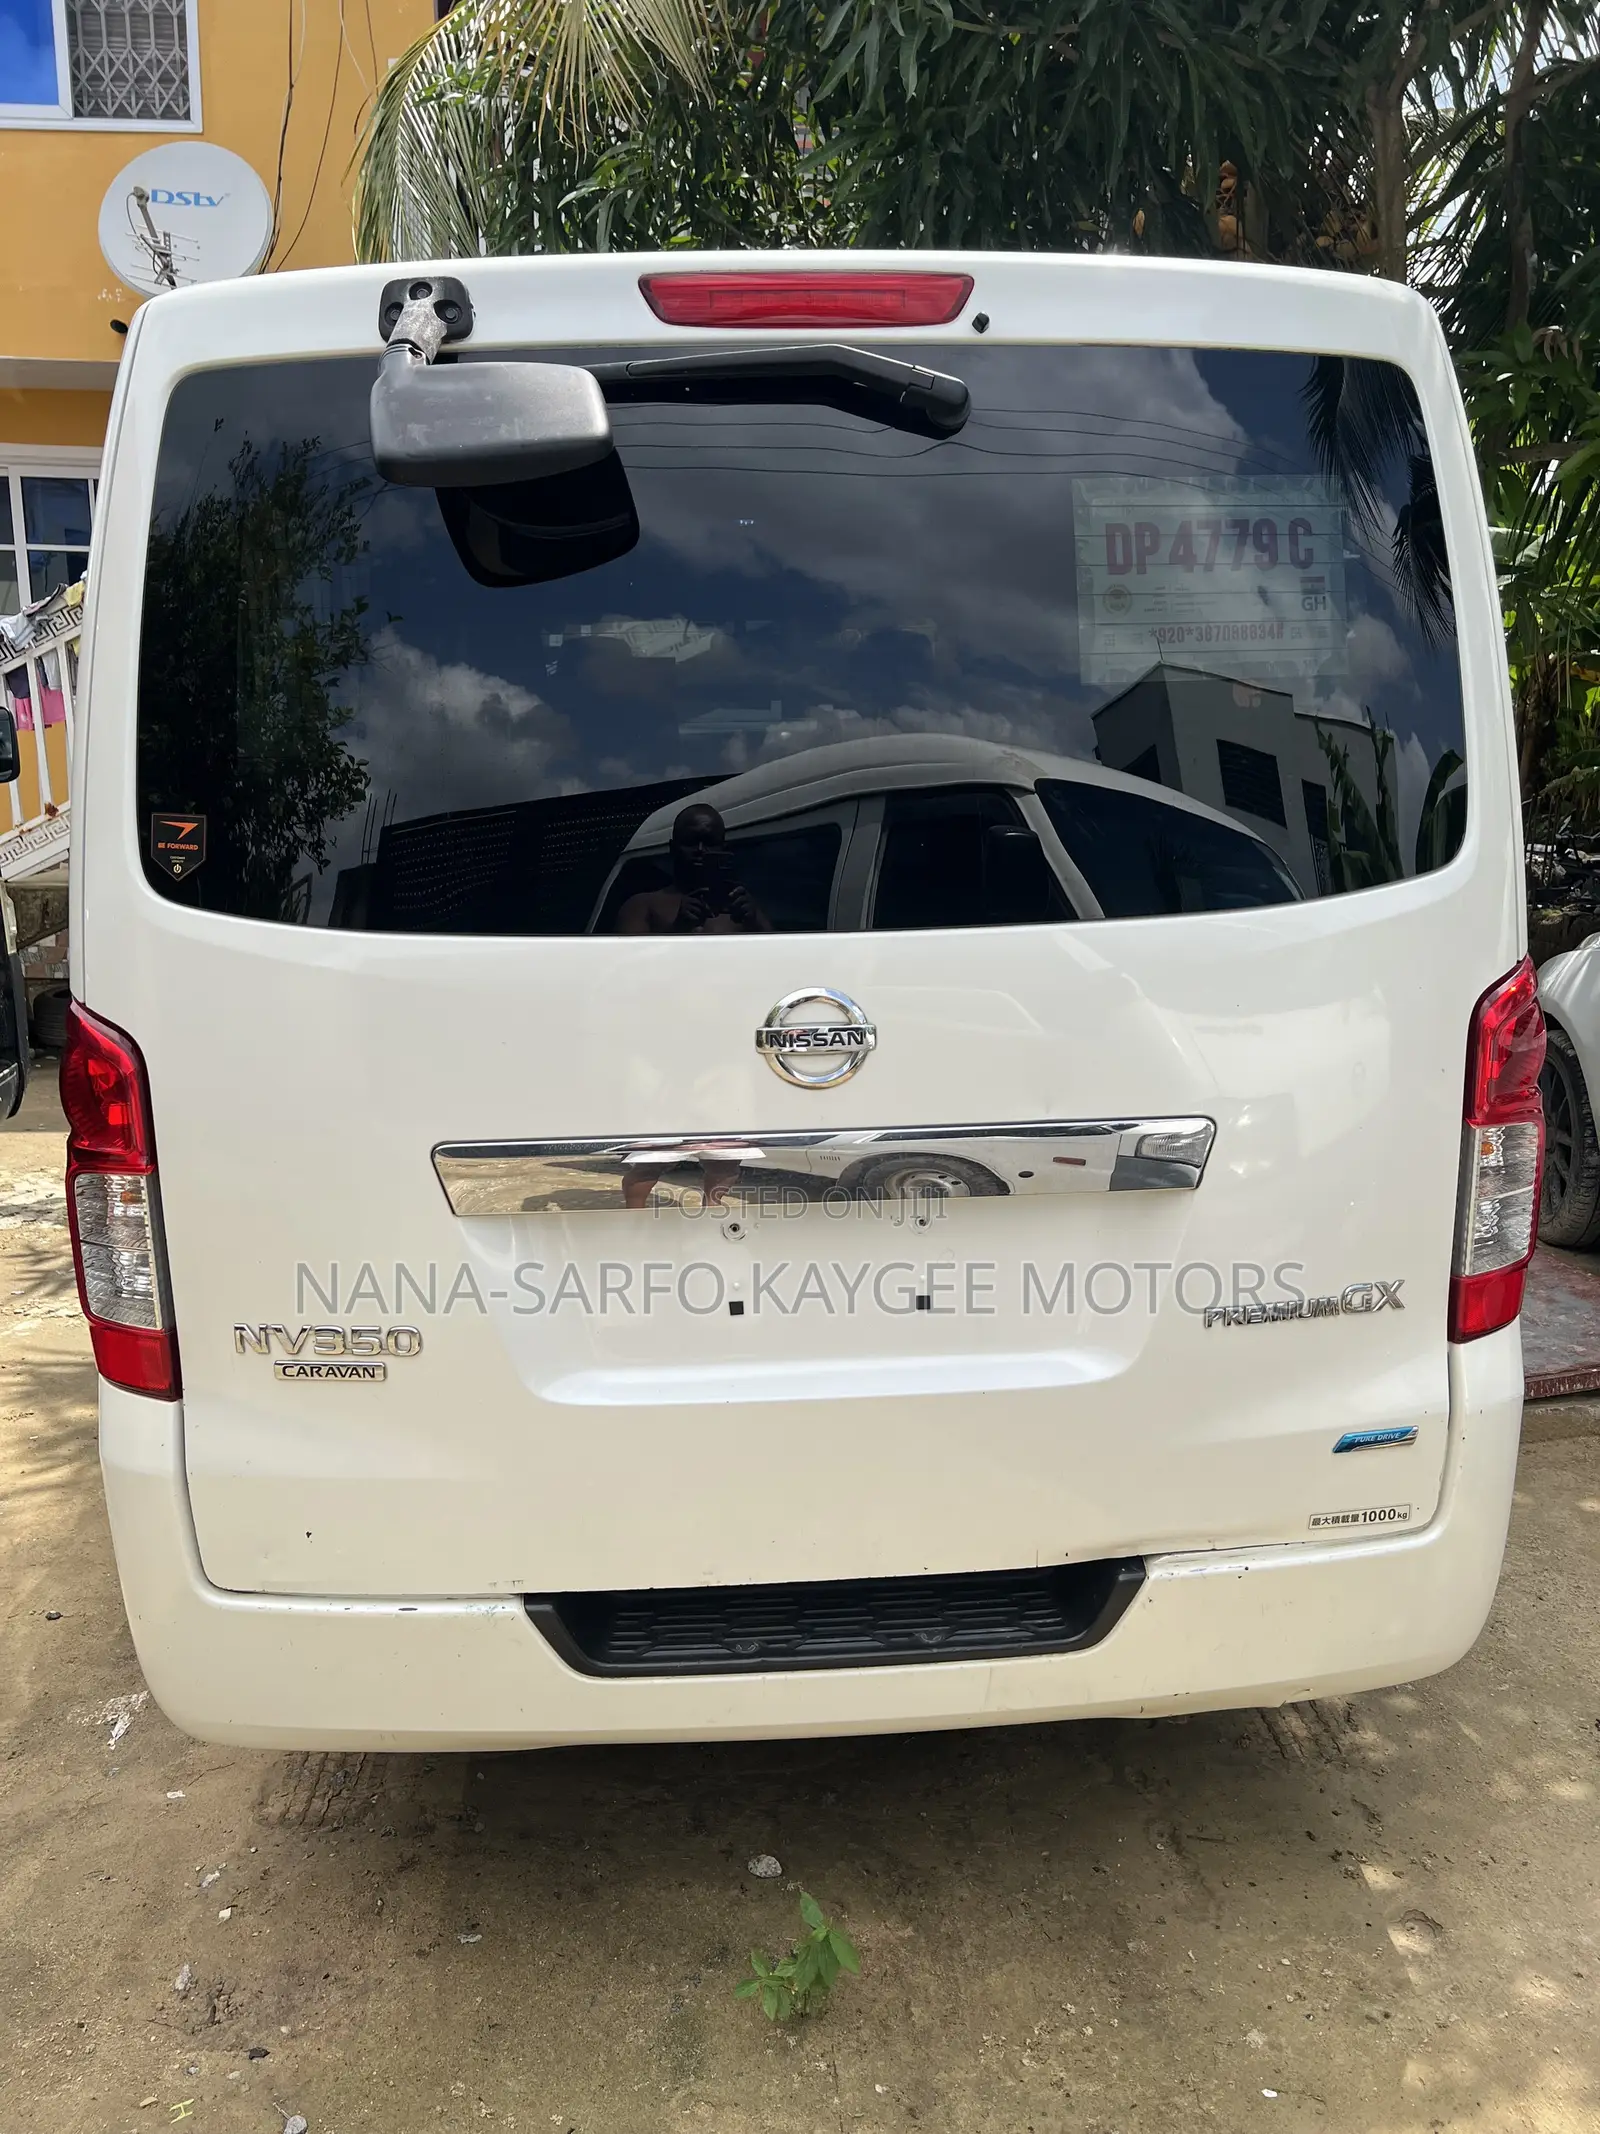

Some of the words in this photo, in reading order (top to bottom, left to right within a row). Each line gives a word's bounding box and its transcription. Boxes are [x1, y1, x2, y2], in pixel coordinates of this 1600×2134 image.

[1105, 521, 1160, 575] DP
[1168, 518, 1279, 574] 4779
[1288, 517, 1314, 570] C
[1301, 595, 1327, 611] GH
[167, 842, 199, 851] FORWARD
[769, 1030, 864, 1048] NISSAN
[1204, 1295, 1340, 1329] PREMIUM
[1341, 1279, 1405, 1316] GX
[233, 1322, 423, 1357] NV350
[281, 1365, 376, 1379] CARAVAN
[1377, 1431, 1401, 1441] DRIVE
